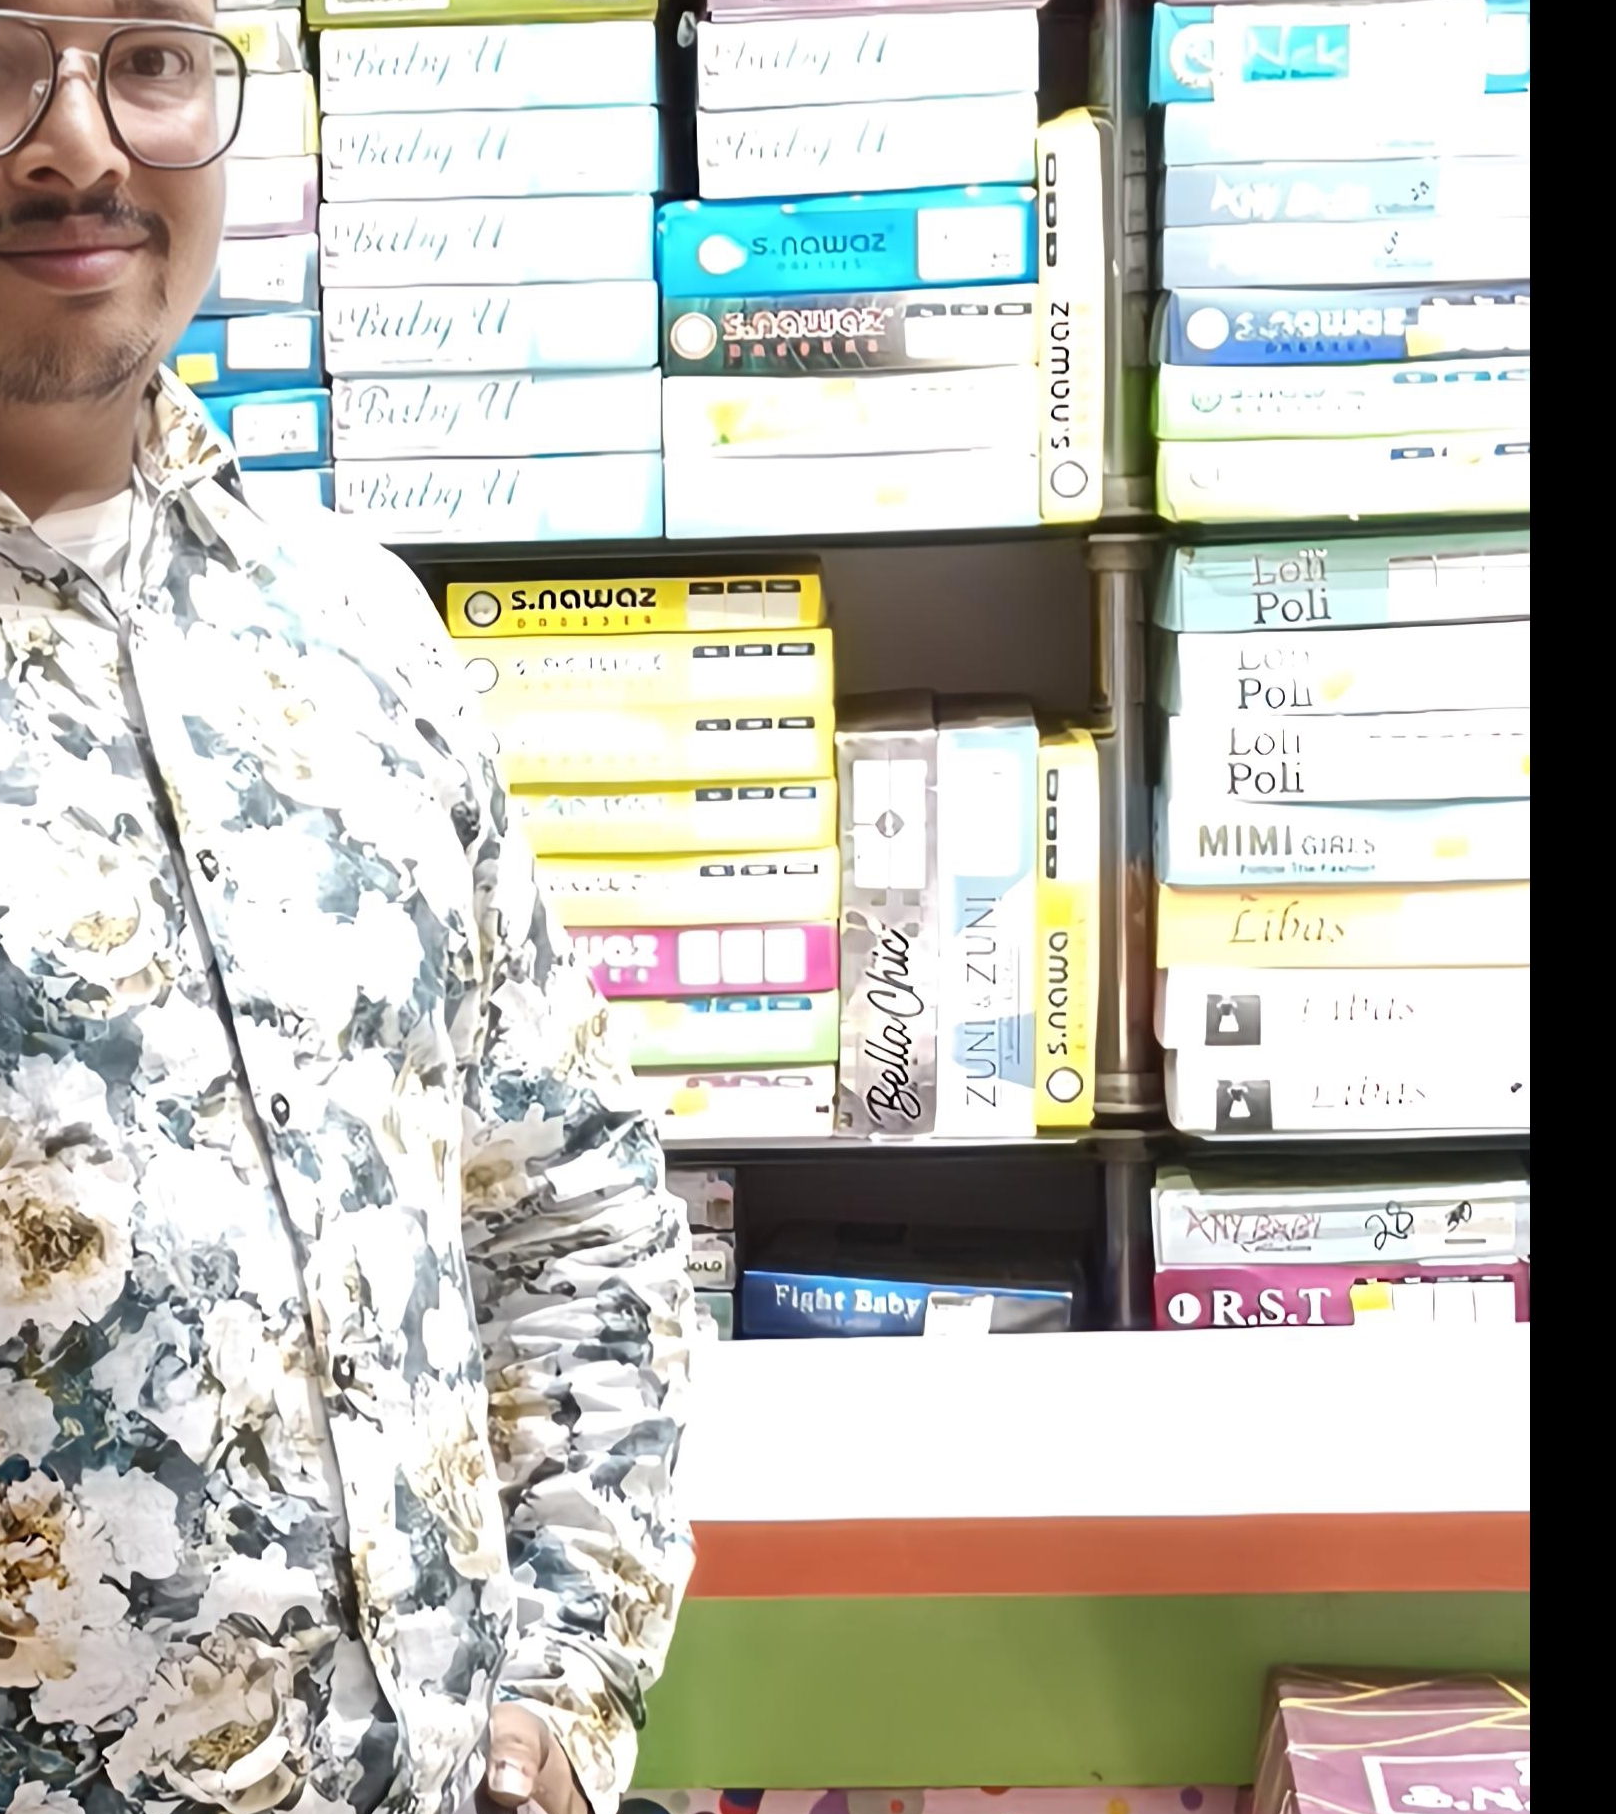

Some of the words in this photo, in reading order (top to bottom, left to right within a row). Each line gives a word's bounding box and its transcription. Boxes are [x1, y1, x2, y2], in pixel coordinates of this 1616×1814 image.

[751, 232, 889, 255] s.nawaz
[1048, 301, 1071, 450] s.nawaz
[511, 586, 658, 612] s.nawaz
[1253, 588, 1332, 625] Poli
[1238, 678, 1312, 709] Poli
[1227, 762, 1305, 795] Poli
[1199, 825, 1292, 857] MIMI
[964, 895, 997, 985] ZUNI
[862, 927, 925, 1018] Chic
[1047, 930, 1069, 1056] s.nawa
[863, 1016, 922, 1122] Bella
[964, 1018, 997, 1108] ZUNI
[1364, 1200, 1414, 1251] 28
[774, 1283, 845, 1313] Fight
[853, 1288, 922, 1323] Baby
[1213, 1287, 1332, 1325] R.S.T
